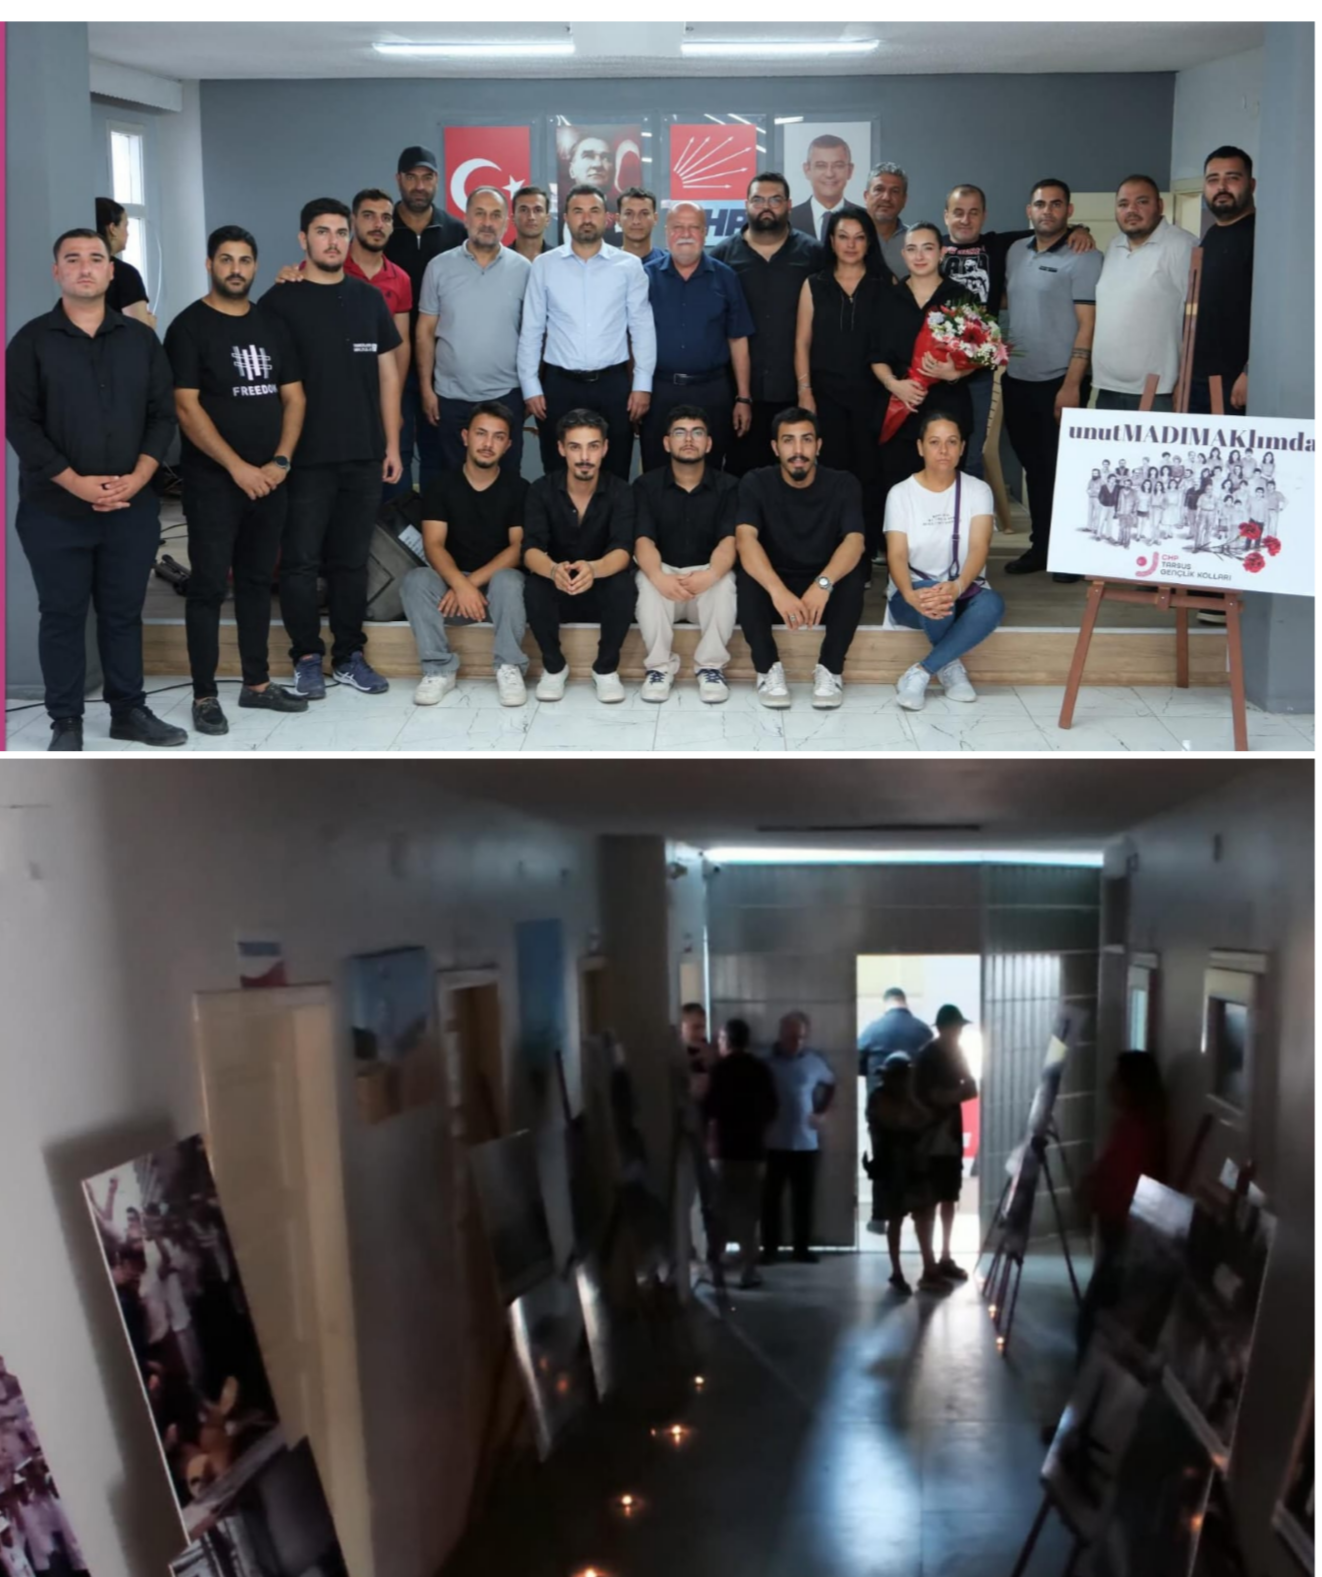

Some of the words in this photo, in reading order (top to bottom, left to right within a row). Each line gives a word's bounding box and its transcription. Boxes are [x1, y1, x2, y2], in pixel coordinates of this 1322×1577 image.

[705, 208, 748, 237] HP
[1161, 561, 1192, 570] TARSUS
[1160, 568, 1195, 577] GENÇLİK
[1197, 571, 1232, 581] KOLLARI
